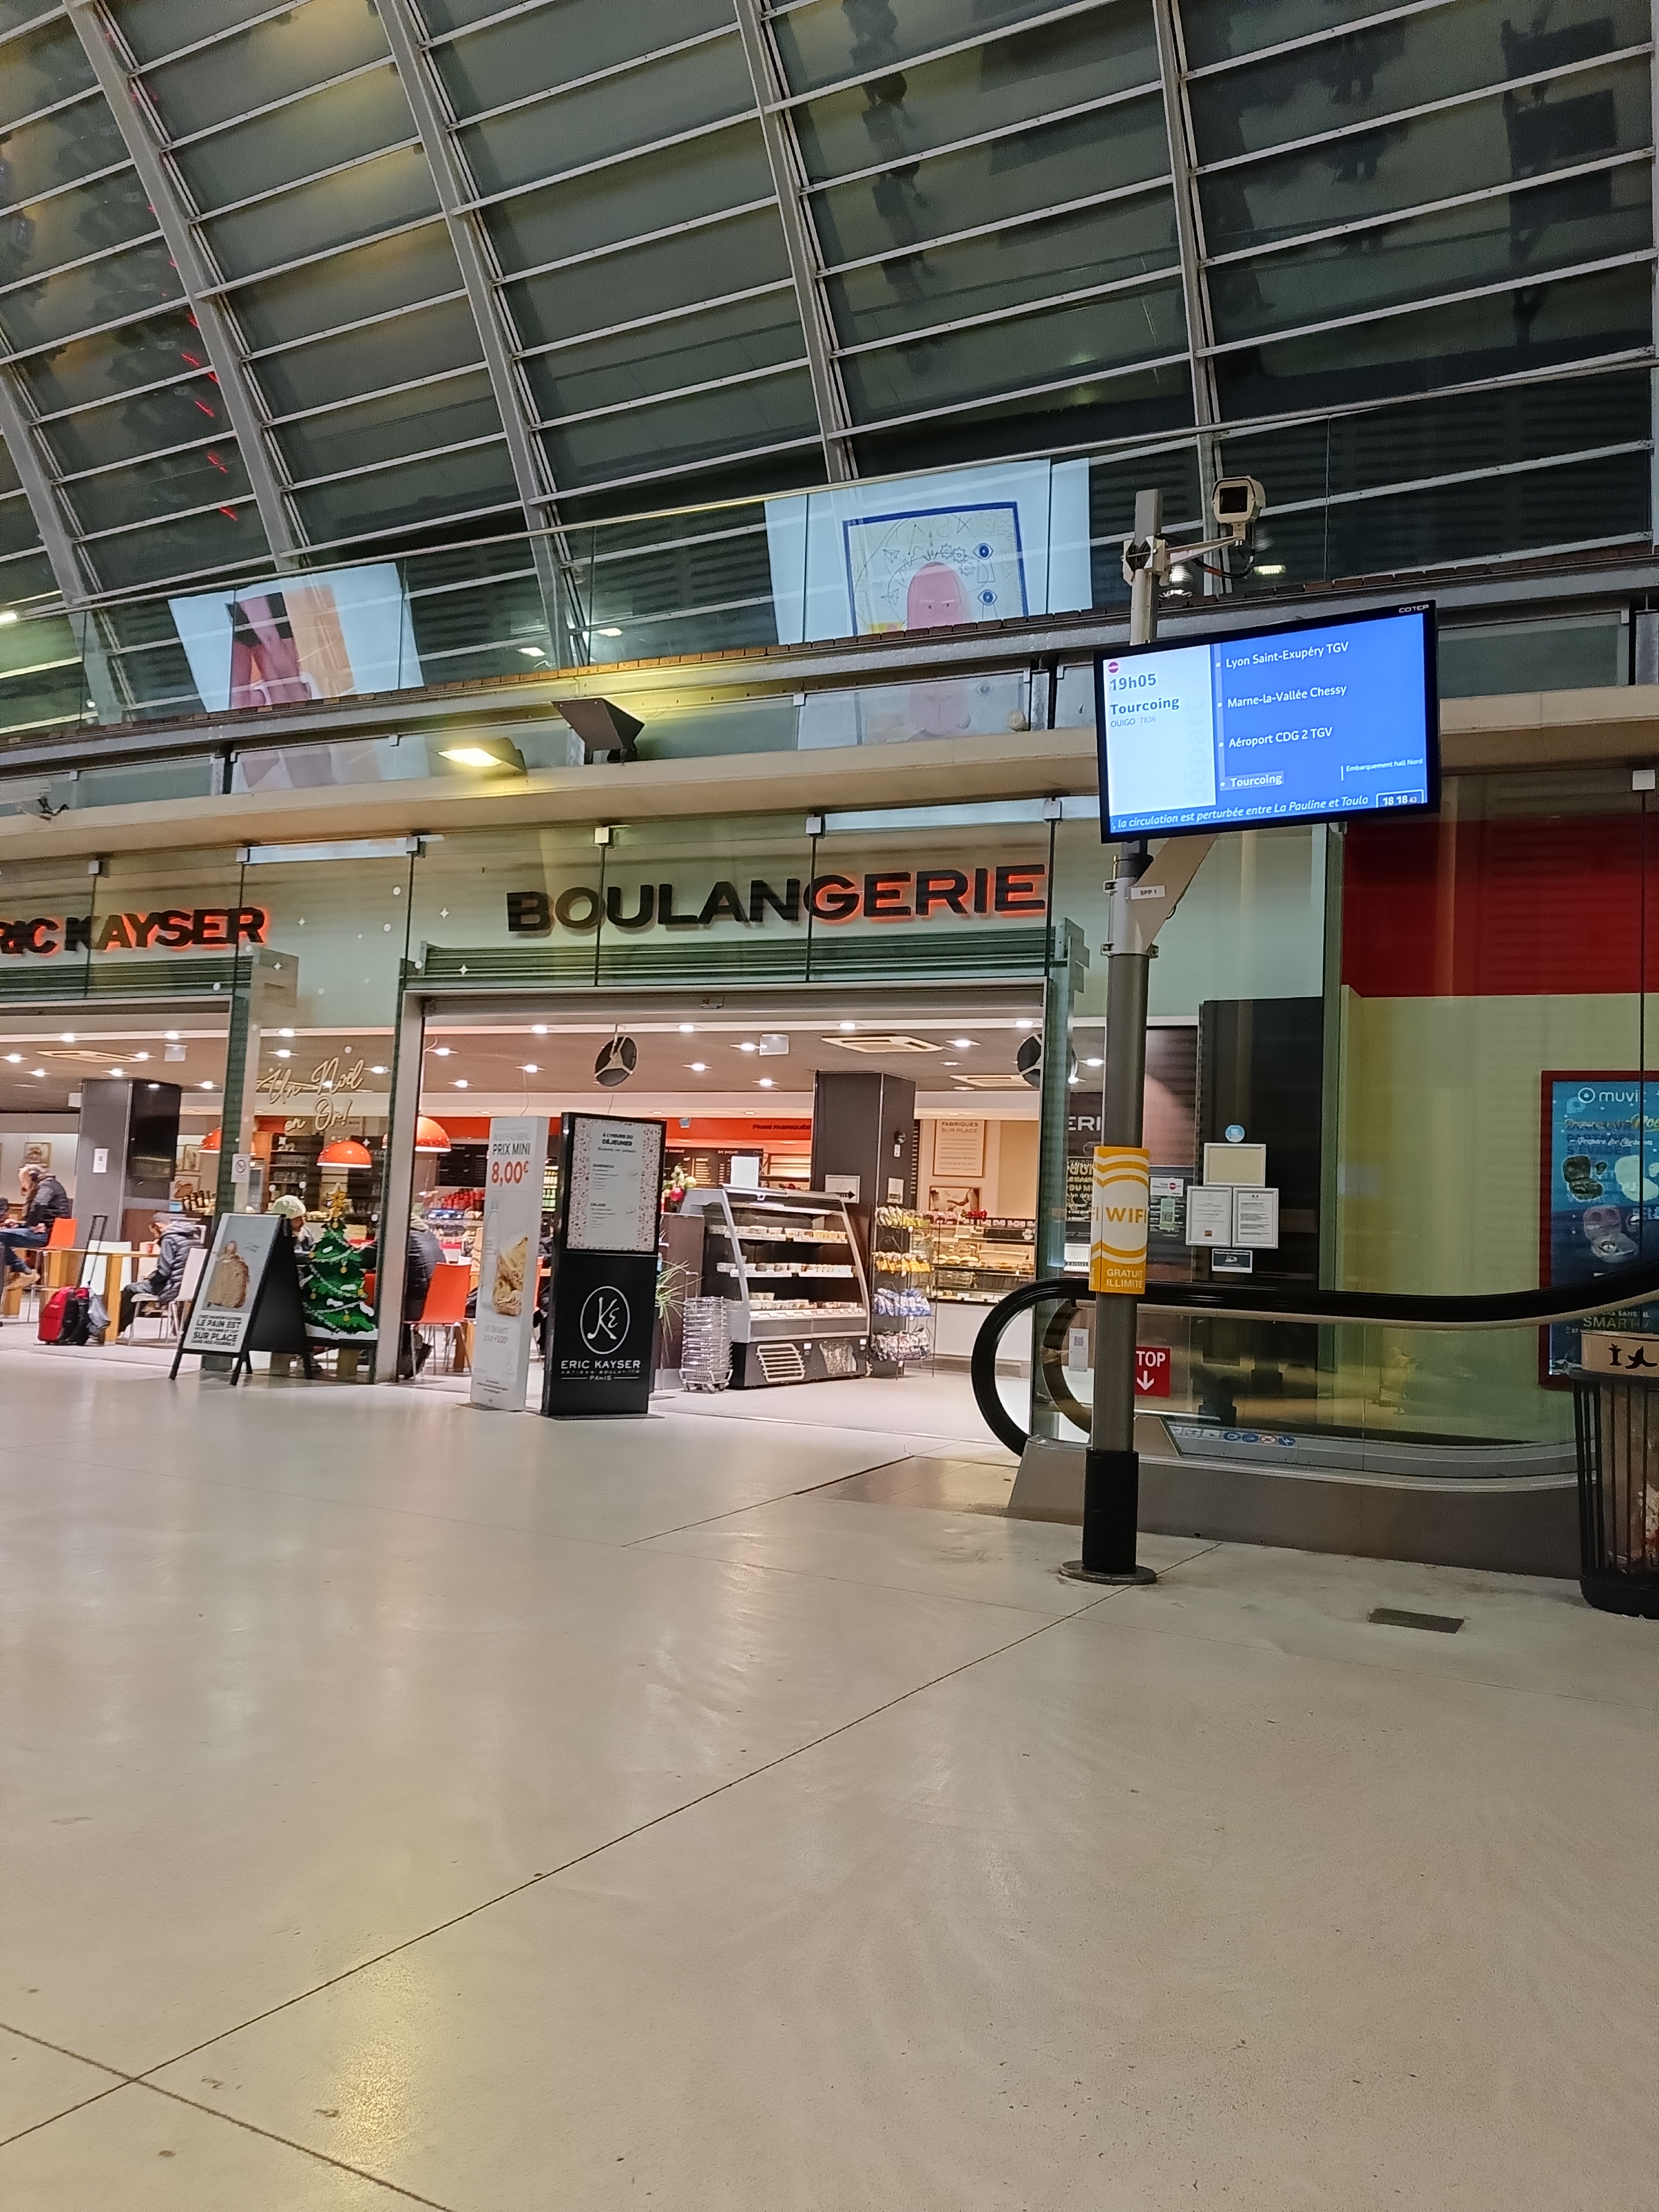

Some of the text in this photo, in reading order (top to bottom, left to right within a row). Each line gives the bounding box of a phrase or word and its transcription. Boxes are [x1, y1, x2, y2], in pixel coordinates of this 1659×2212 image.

[1226, 641, 1349, 670] Lyon Saint-Exupéry TGV
[1110, 673, 1156, 691] 19h05
[1228, 685, 1347, 708] Marne-la-Vallée Chessy
[1110, 698, 1180, 715] Tourcoing
[1110, 716, 1156, 728] OUIGO 7836
[1229, 727, 1333, 748] Aéroport CDG 2 TGV
[1346, 761, 1393, 772] Embarquement
[1230, 774, 1283, 787] Tourcoing
[1383, 796, 1395, 806] 18
[1396, 795, 1408, 805] 18
[1118, 795, 1369, 828] la circulation est perturbée entre La Pauline et Toulo
[506, 864, 1046, 933] BOULANGERIE
[65, 907, 265, 951] KAYSER
[311, 1057, 364, 1095] Noël
[1599, 1089, 1647, 1103] muvi
[285, 1117, 307, 1131] en
[492, 1142, 531, 1156] PRIX MINI
[492, 1160, 530, 1187] 8,00€
[1105, 1207, 1147, 1224] WIFI
[1107, 1269, 1144, 1278] GRATUIT
[206, 1319, 226, 1328] PAIN
[192, 1331, 238, 1342] SUR PLACE
[561, 1360, 641, 1369] ERIC KAYSER
[1135, 1350, 1166, 1368] TOP
